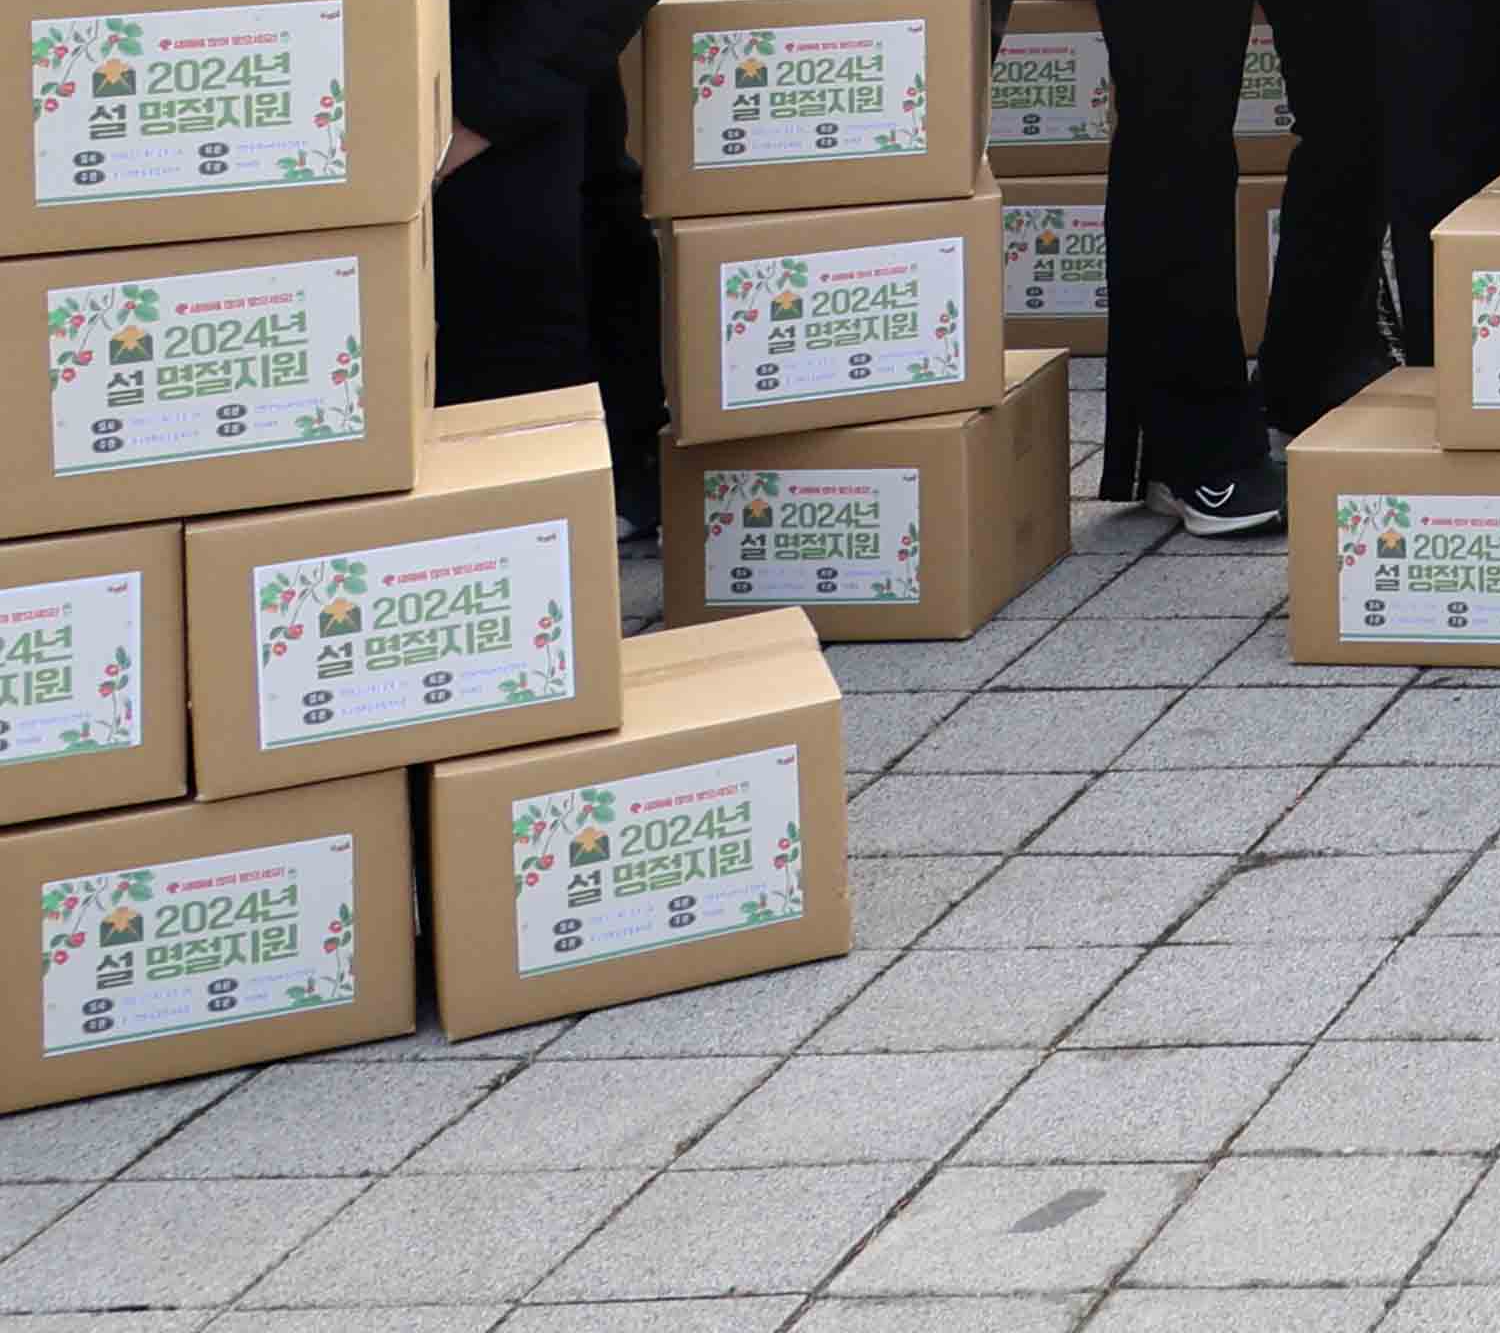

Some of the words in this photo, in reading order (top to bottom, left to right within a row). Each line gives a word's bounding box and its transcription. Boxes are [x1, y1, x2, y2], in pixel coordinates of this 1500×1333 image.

[148, 50, 292, 97] 2024년
[777, 53, 884, 88] 2024년
[88, 104, 128, 142] 설
[138, 90, 293, 139] 명절지원
[733, 93, 762, 121] 설
[770, 84, 885, 119] 명절지원
[811, 279, 918, 319] 2024년
[164, 309, 308, 362] 2024년
[767, 325, 796, 356] 설
[804, 310, 919, 352] 명절지원
[106, 370, 146, 409] 설
[156, 348, 310, 404] 명절지원
[781, 501, 880, 529] 2024년
[741, 533, 767, 560] 설
[775, 531, 881, 560] 명절지원
[372, 576, 511, 633] 2024년
[1374, 565, 1400, 592] 설
[316, 641, 355, 682] 설
[364, 614, 513, 674] 명절지원
[620, 799, 752, 860] 2024년
[566, 869, 603, 910] 설
[612, 836, 754, 901] 명절지원
[156, 882, 299, 941] 2024년
[97, 950, 136, 990] 설
[147, 921, 301, 982] 명절지원
